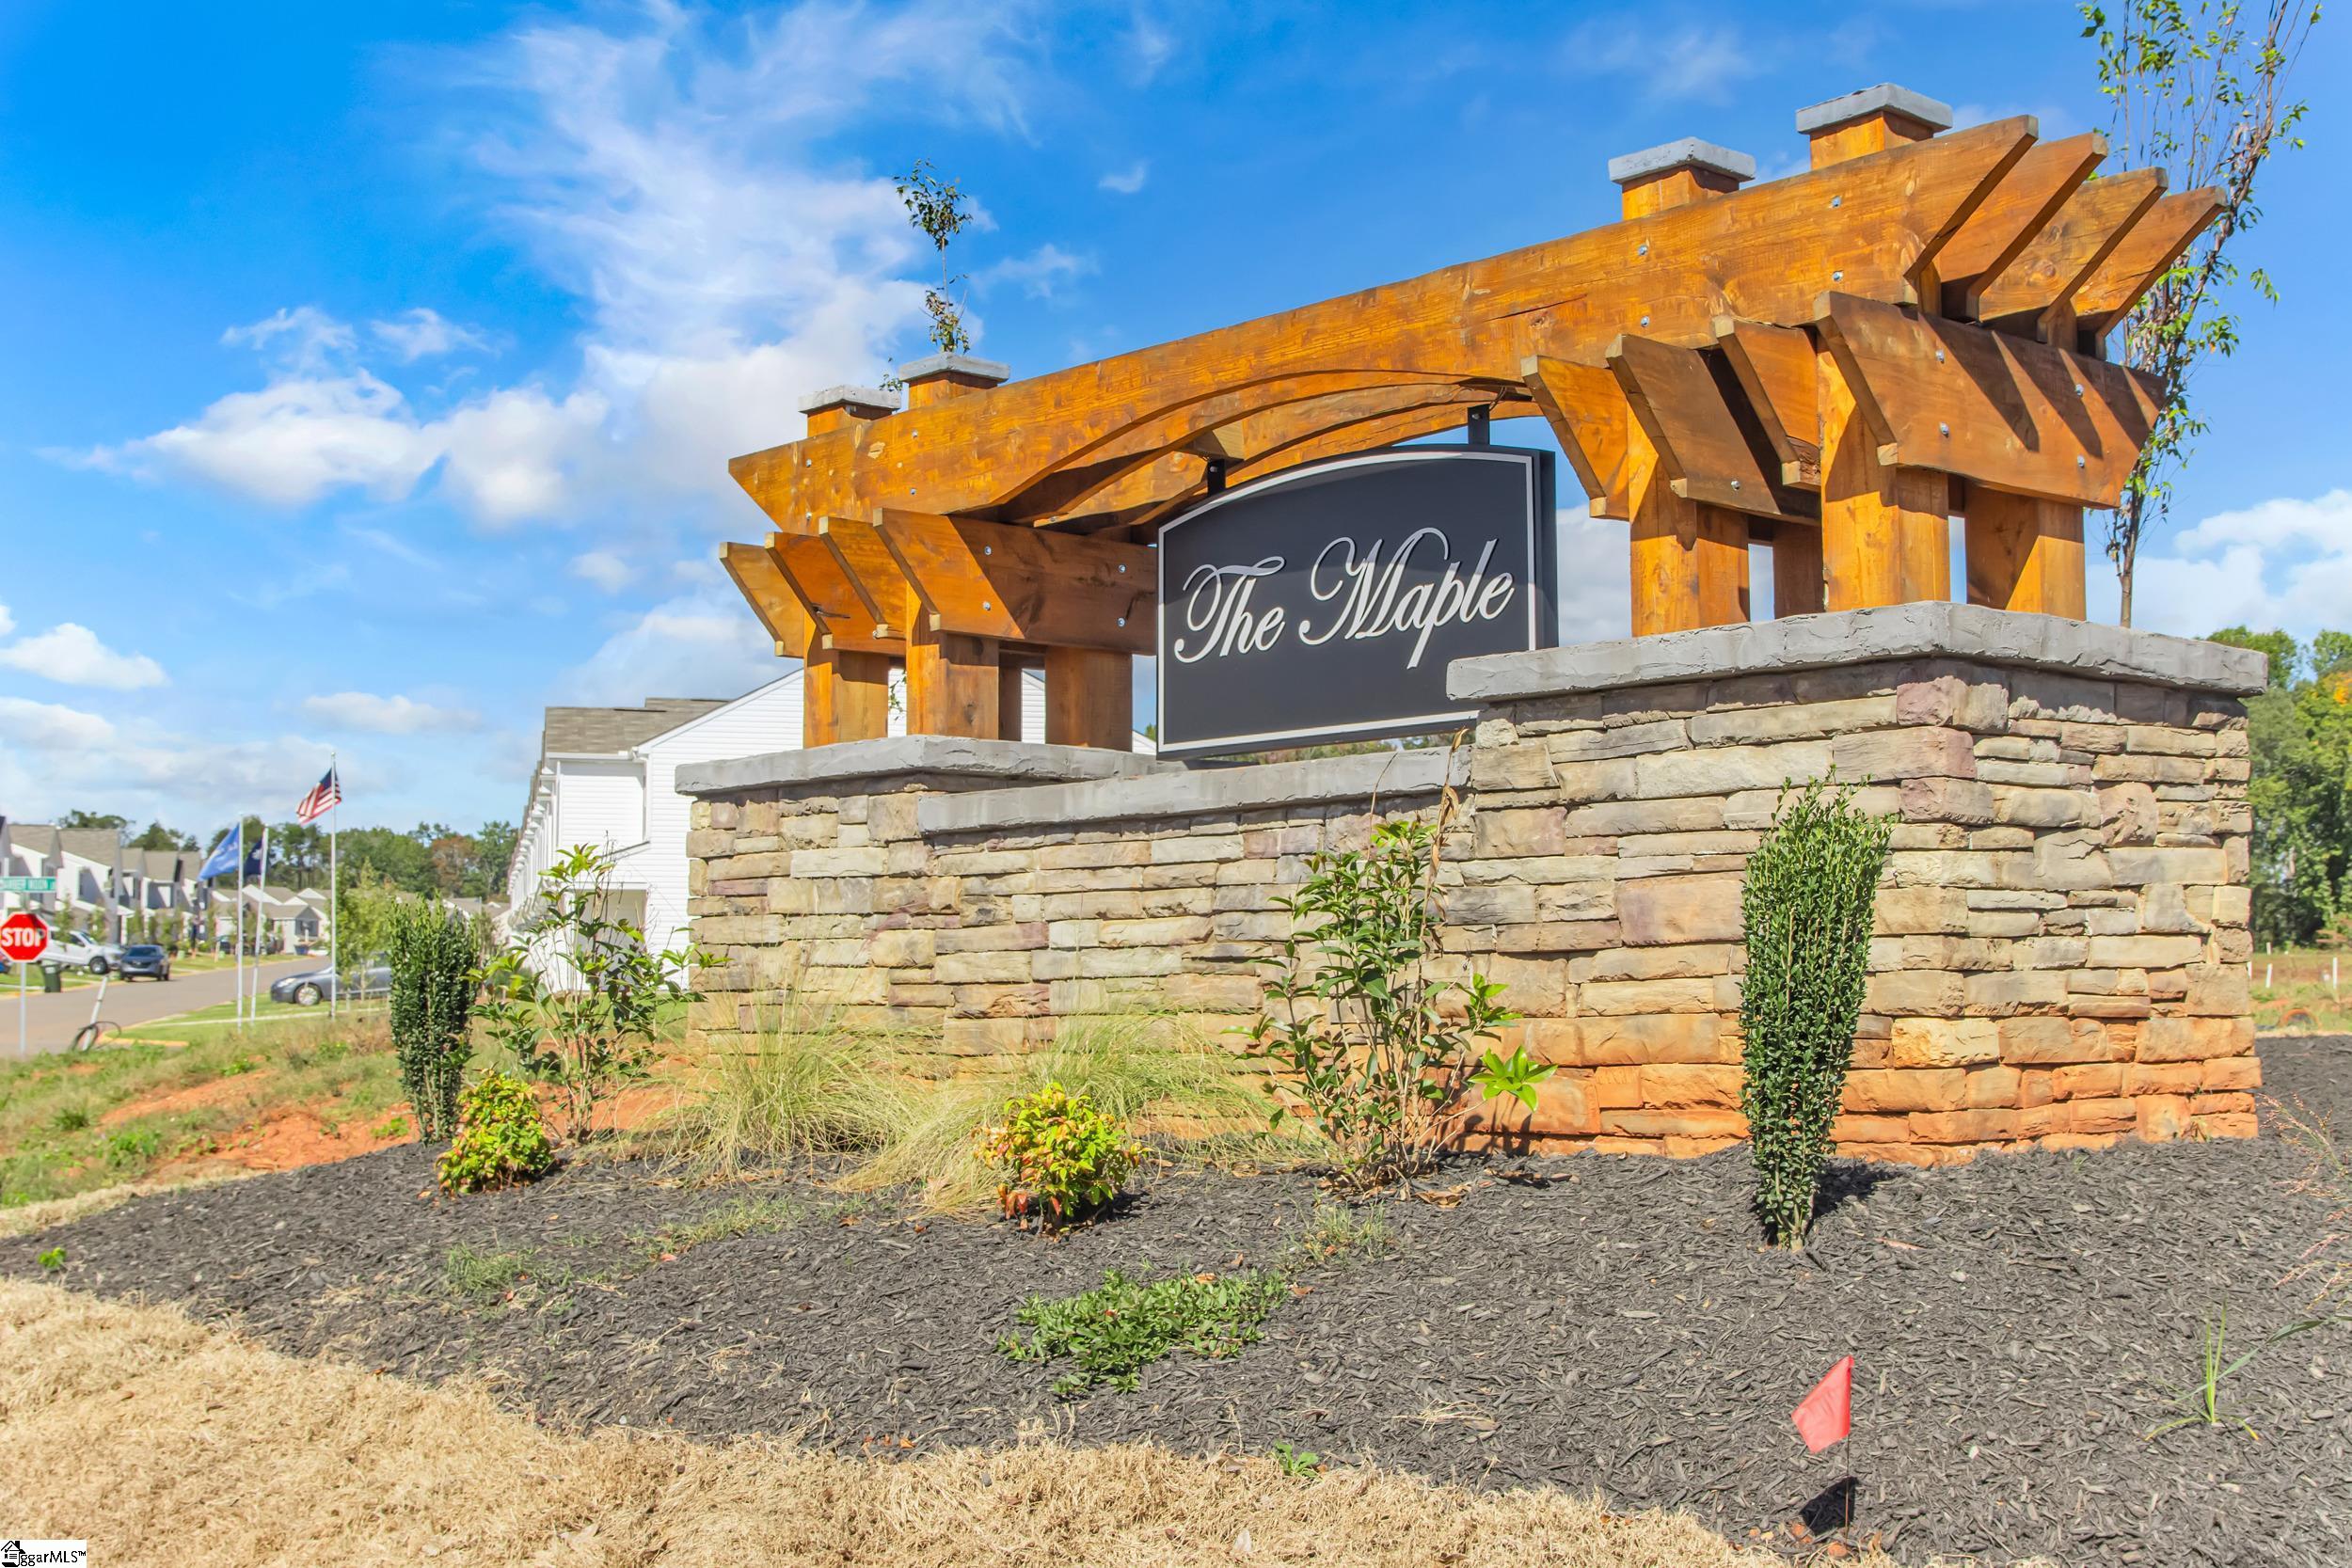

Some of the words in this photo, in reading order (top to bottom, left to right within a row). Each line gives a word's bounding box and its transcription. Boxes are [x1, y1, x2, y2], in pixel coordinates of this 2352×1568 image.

[1174, 556, 1285, 663] The
[1298, 527, 1515, 670] Maple
[1, 927, 45, 947] STOP
